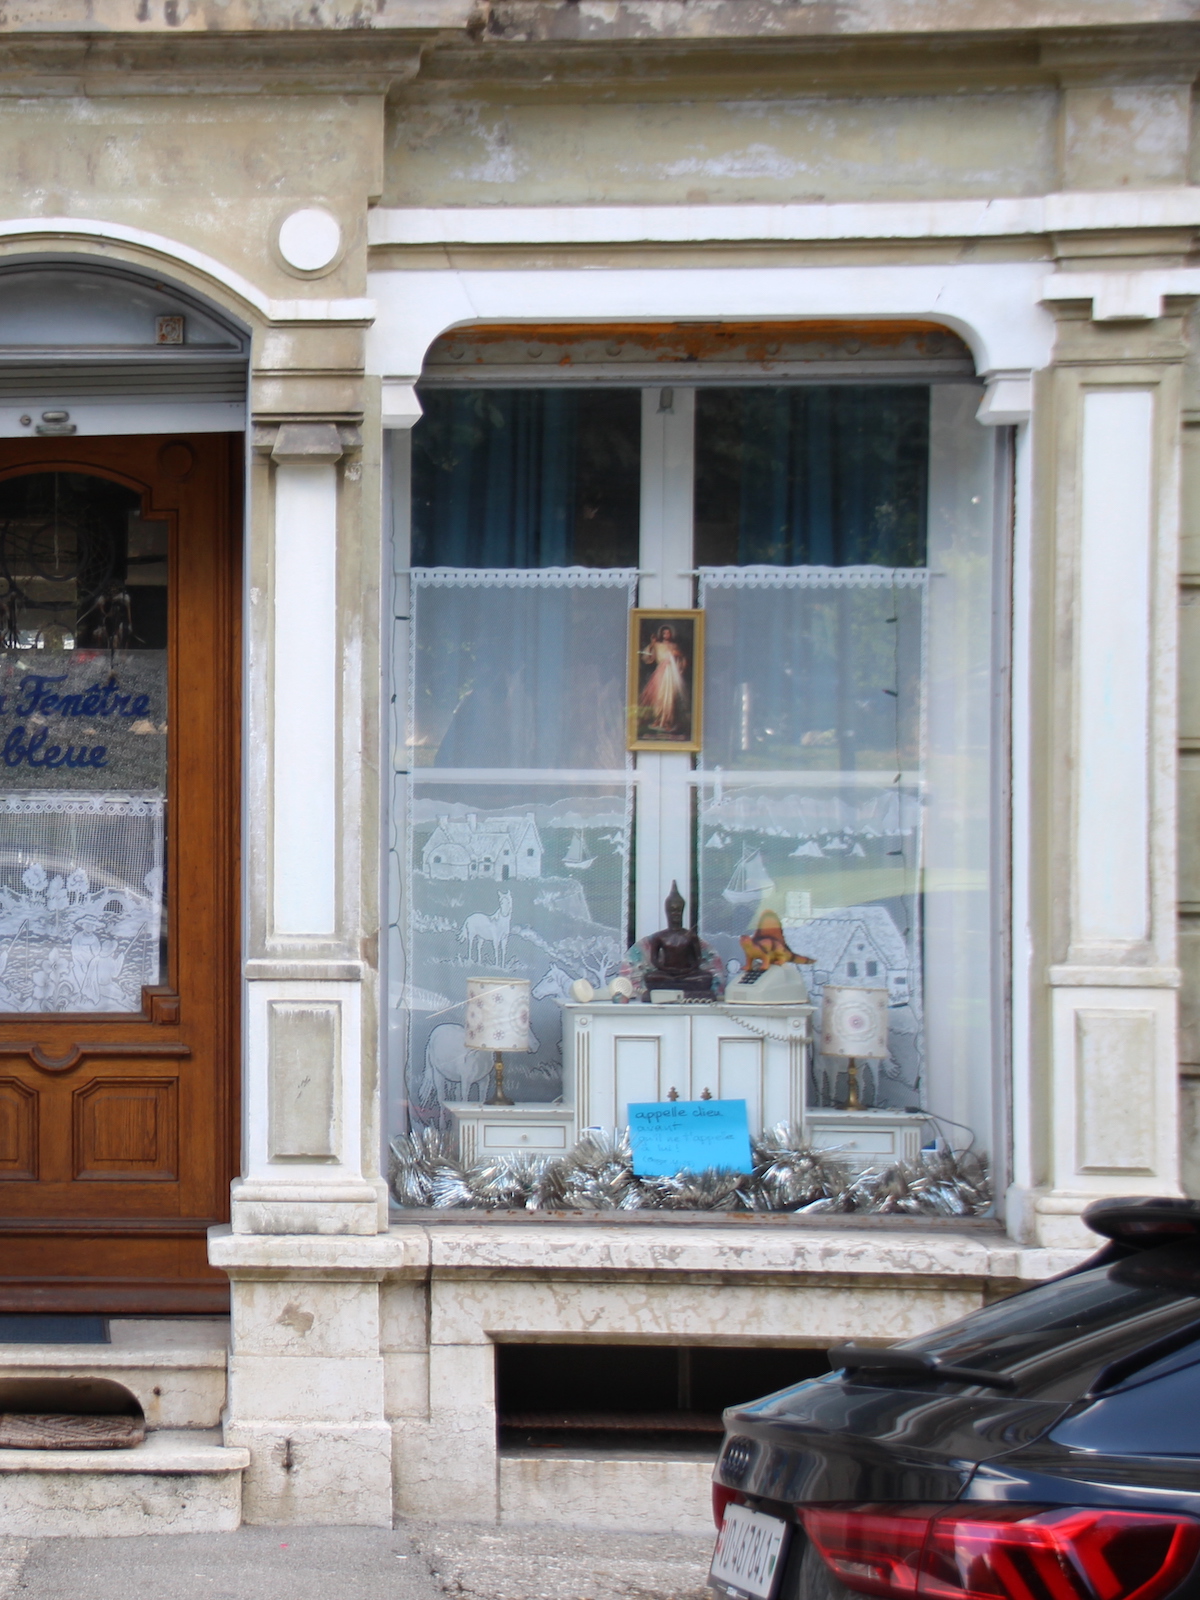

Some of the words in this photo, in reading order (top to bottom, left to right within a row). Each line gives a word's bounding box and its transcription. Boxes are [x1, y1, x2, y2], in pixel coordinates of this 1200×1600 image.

[15, 674, 150, 717] Fenêtre
[1, 725, 109, 768] bleue
[635, 1106, 687, 1123] appelle
[692, 1106, 724, 1117] dieu
[637, 1122, 682, 1132] avant
